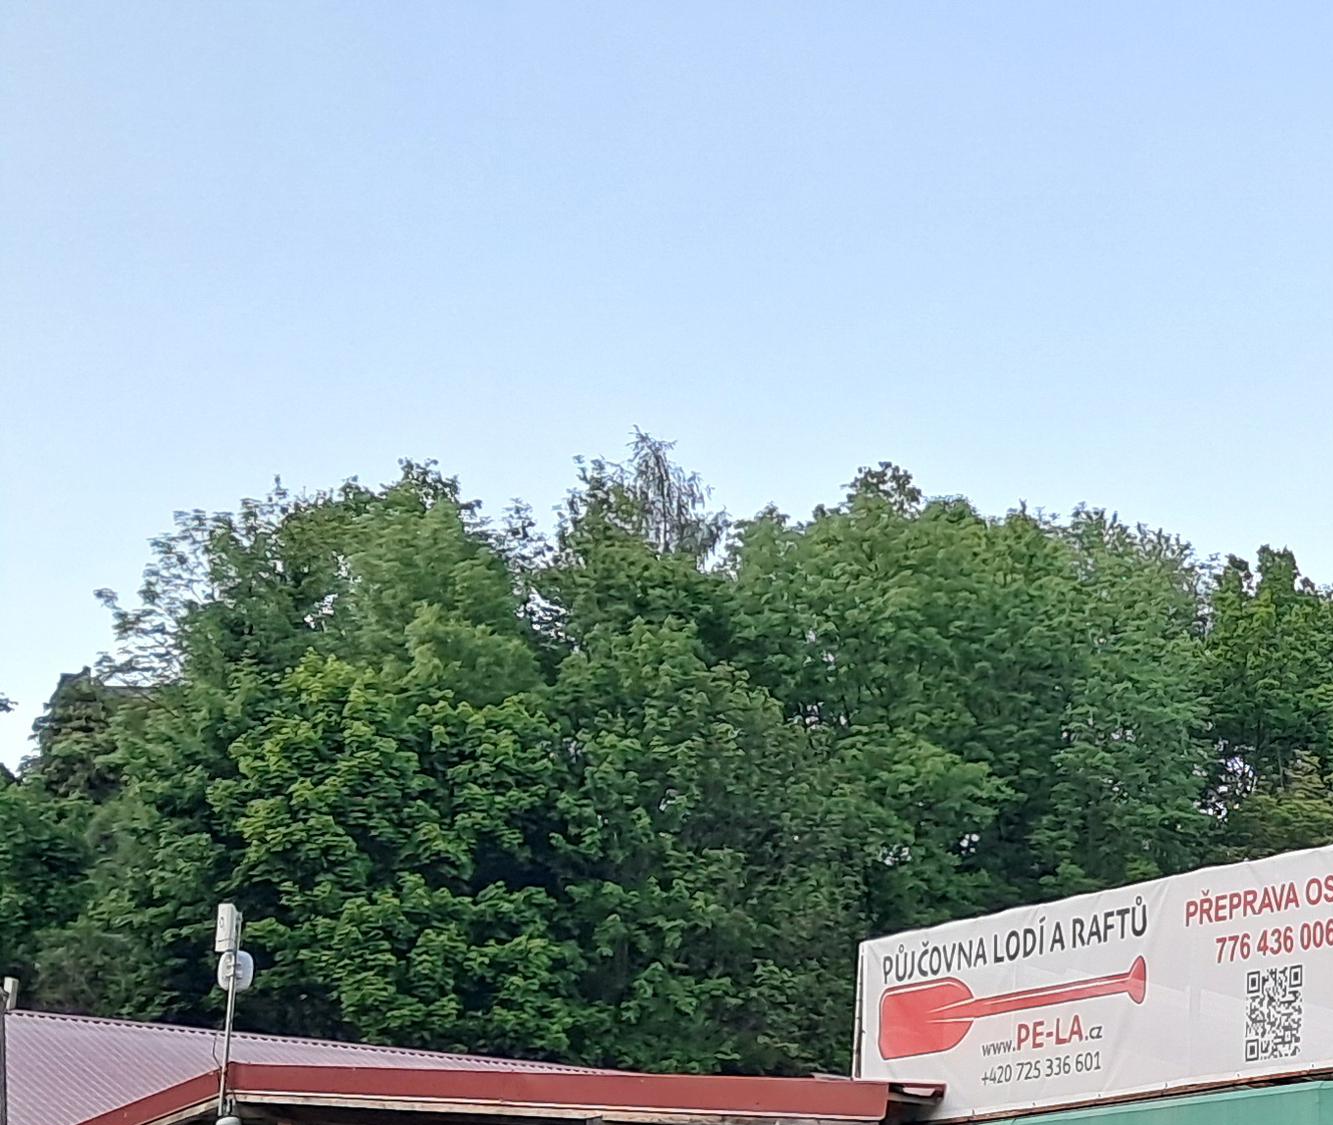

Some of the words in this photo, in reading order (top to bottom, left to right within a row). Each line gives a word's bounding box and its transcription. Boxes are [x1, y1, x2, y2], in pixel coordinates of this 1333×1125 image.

[1186, 882, 1299, 927] PŘEPRAVA
[883, 937, 987, 984] PŮJČOVNA
[993, 916, 1046, 963] LODÍ
[1050, 921, 1065, 951] A
[1072, 896, 1147, 948] RAFTŮ
[1216, 933, 1250, 963] 776
[1257, 926, 1294, 956] 436
[982, 1014, 1102, 1056] www.PE-LA.cz
[981, 1064, 1012, 1086] +420
[1016, 1060, 1041, 1081] 725
[1045, 1055, 1071, 1077] 336
[1075, 1051, 1101, 1072] 601
